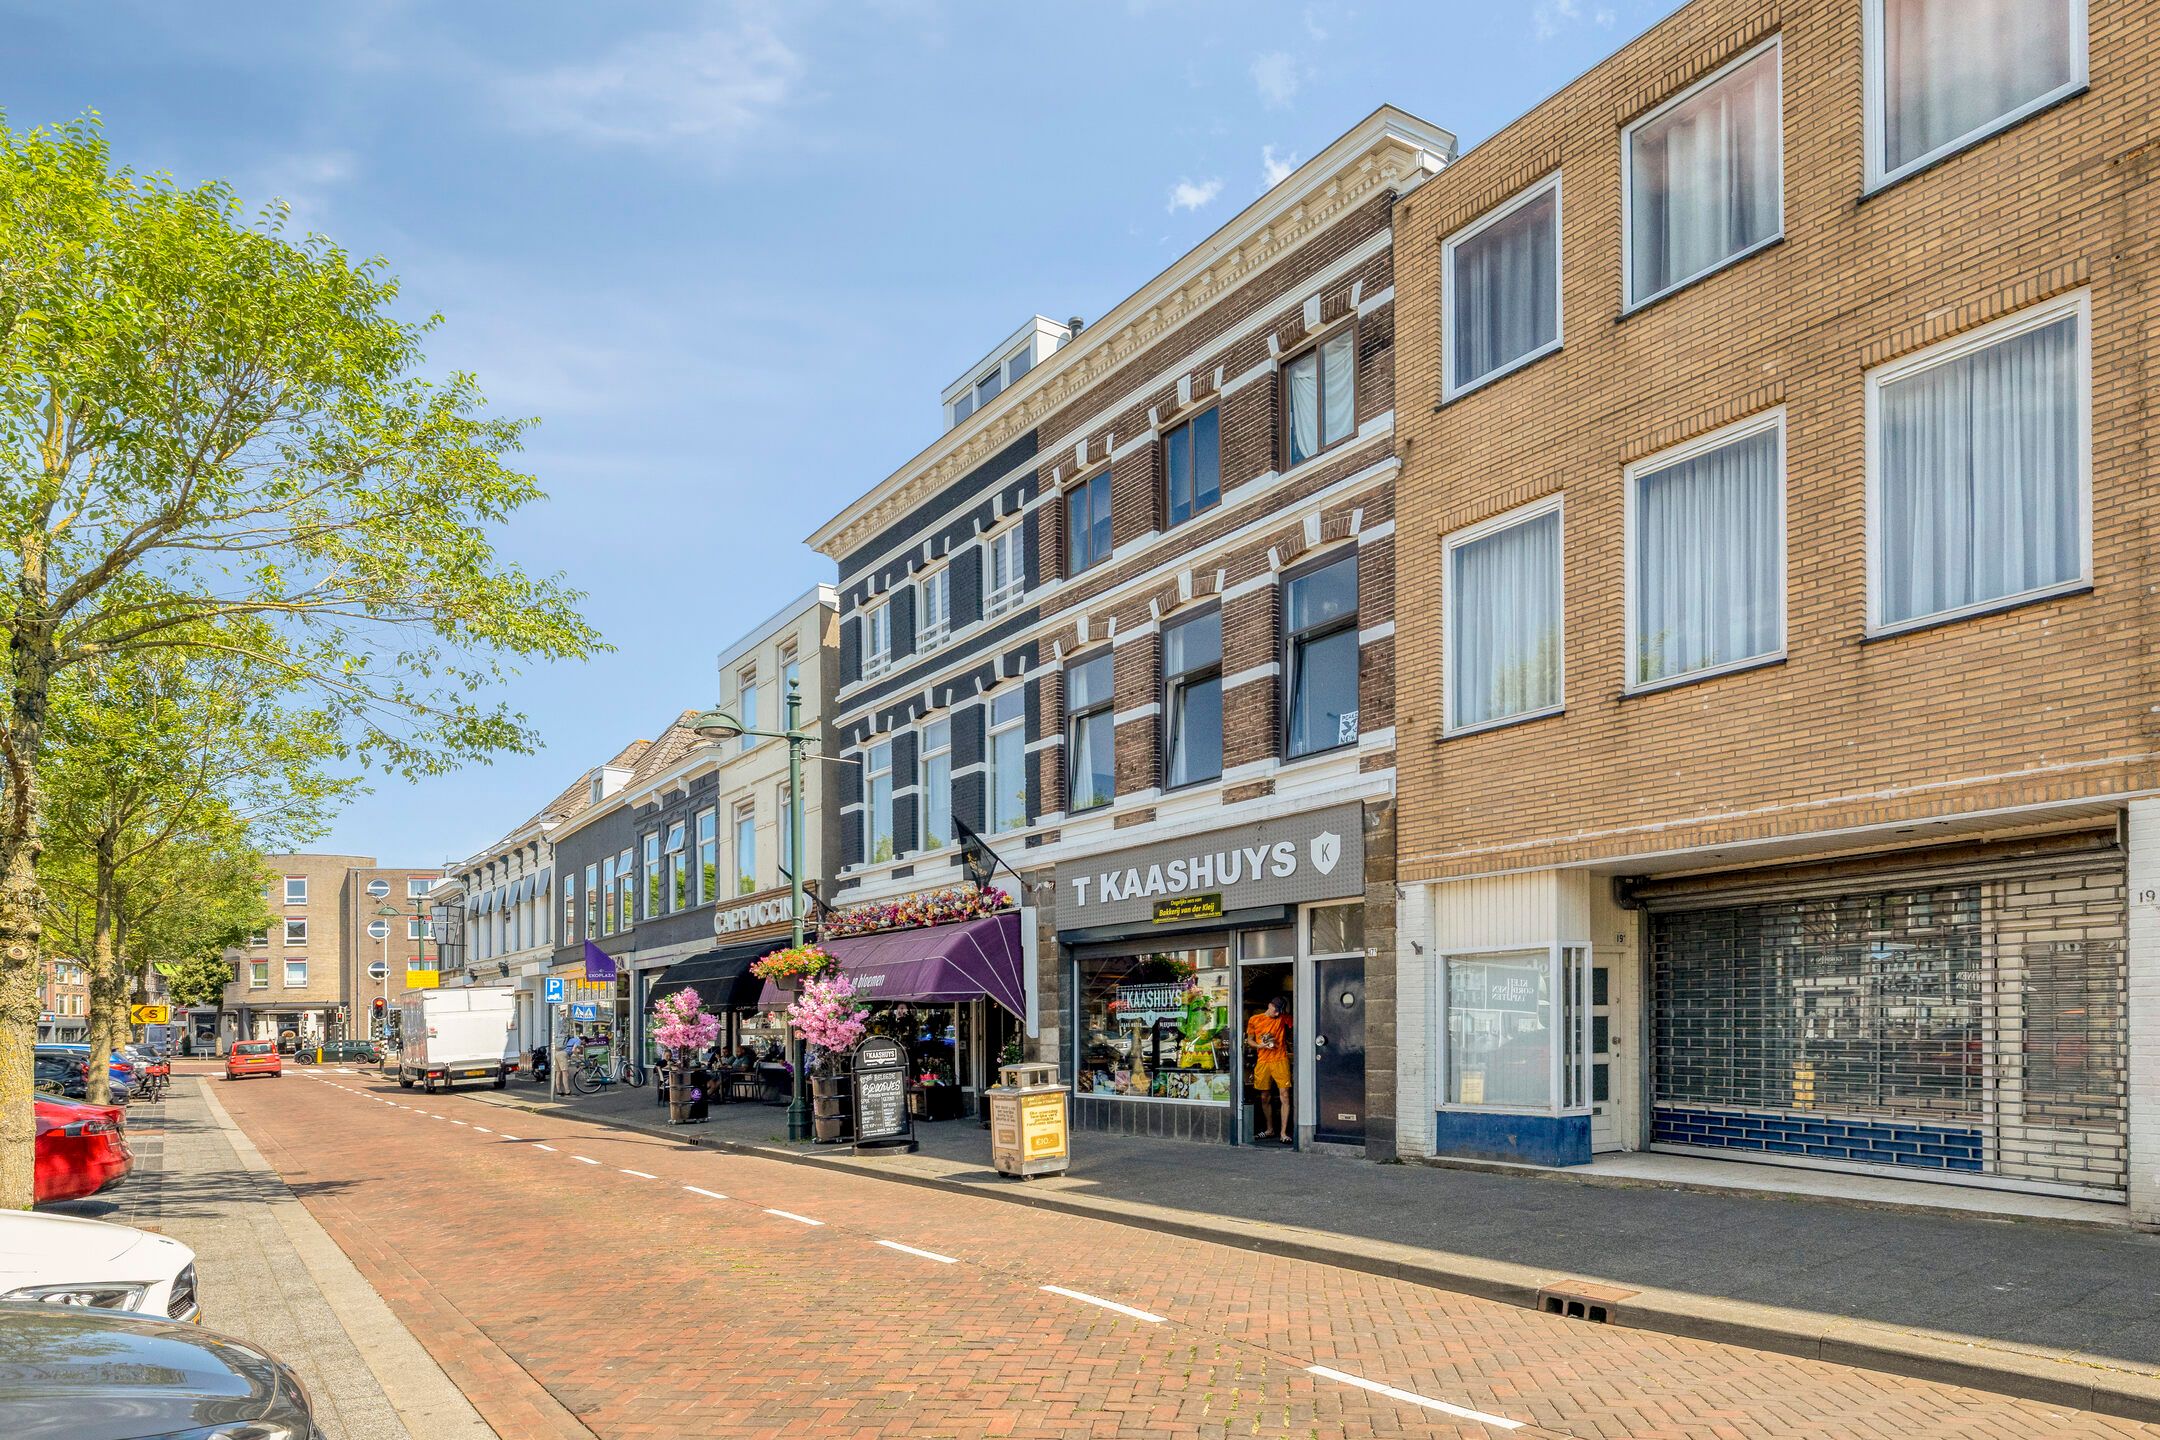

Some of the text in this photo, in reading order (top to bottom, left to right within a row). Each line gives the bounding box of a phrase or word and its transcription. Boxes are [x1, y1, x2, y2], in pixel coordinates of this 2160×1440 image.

[1321, 843, 1330, 863] K
[1072, 841, 1297, 906] T KAASHUYS
[2140, 889, 2156, 903] 19
[1159, 906, 1181, 917] Bakkerij
[1192, 904, 1202, 913] der
[1202, 902, 1215, 912] Kleij
[549, 980, 560, 992] P
[858, 973, 885, 988] bloemen
[1127, 989, 1182, 1009] KAASHUYS
[149, 1009, 158, 1019] S
[862, 1080, 901, 1096] BROODJES
